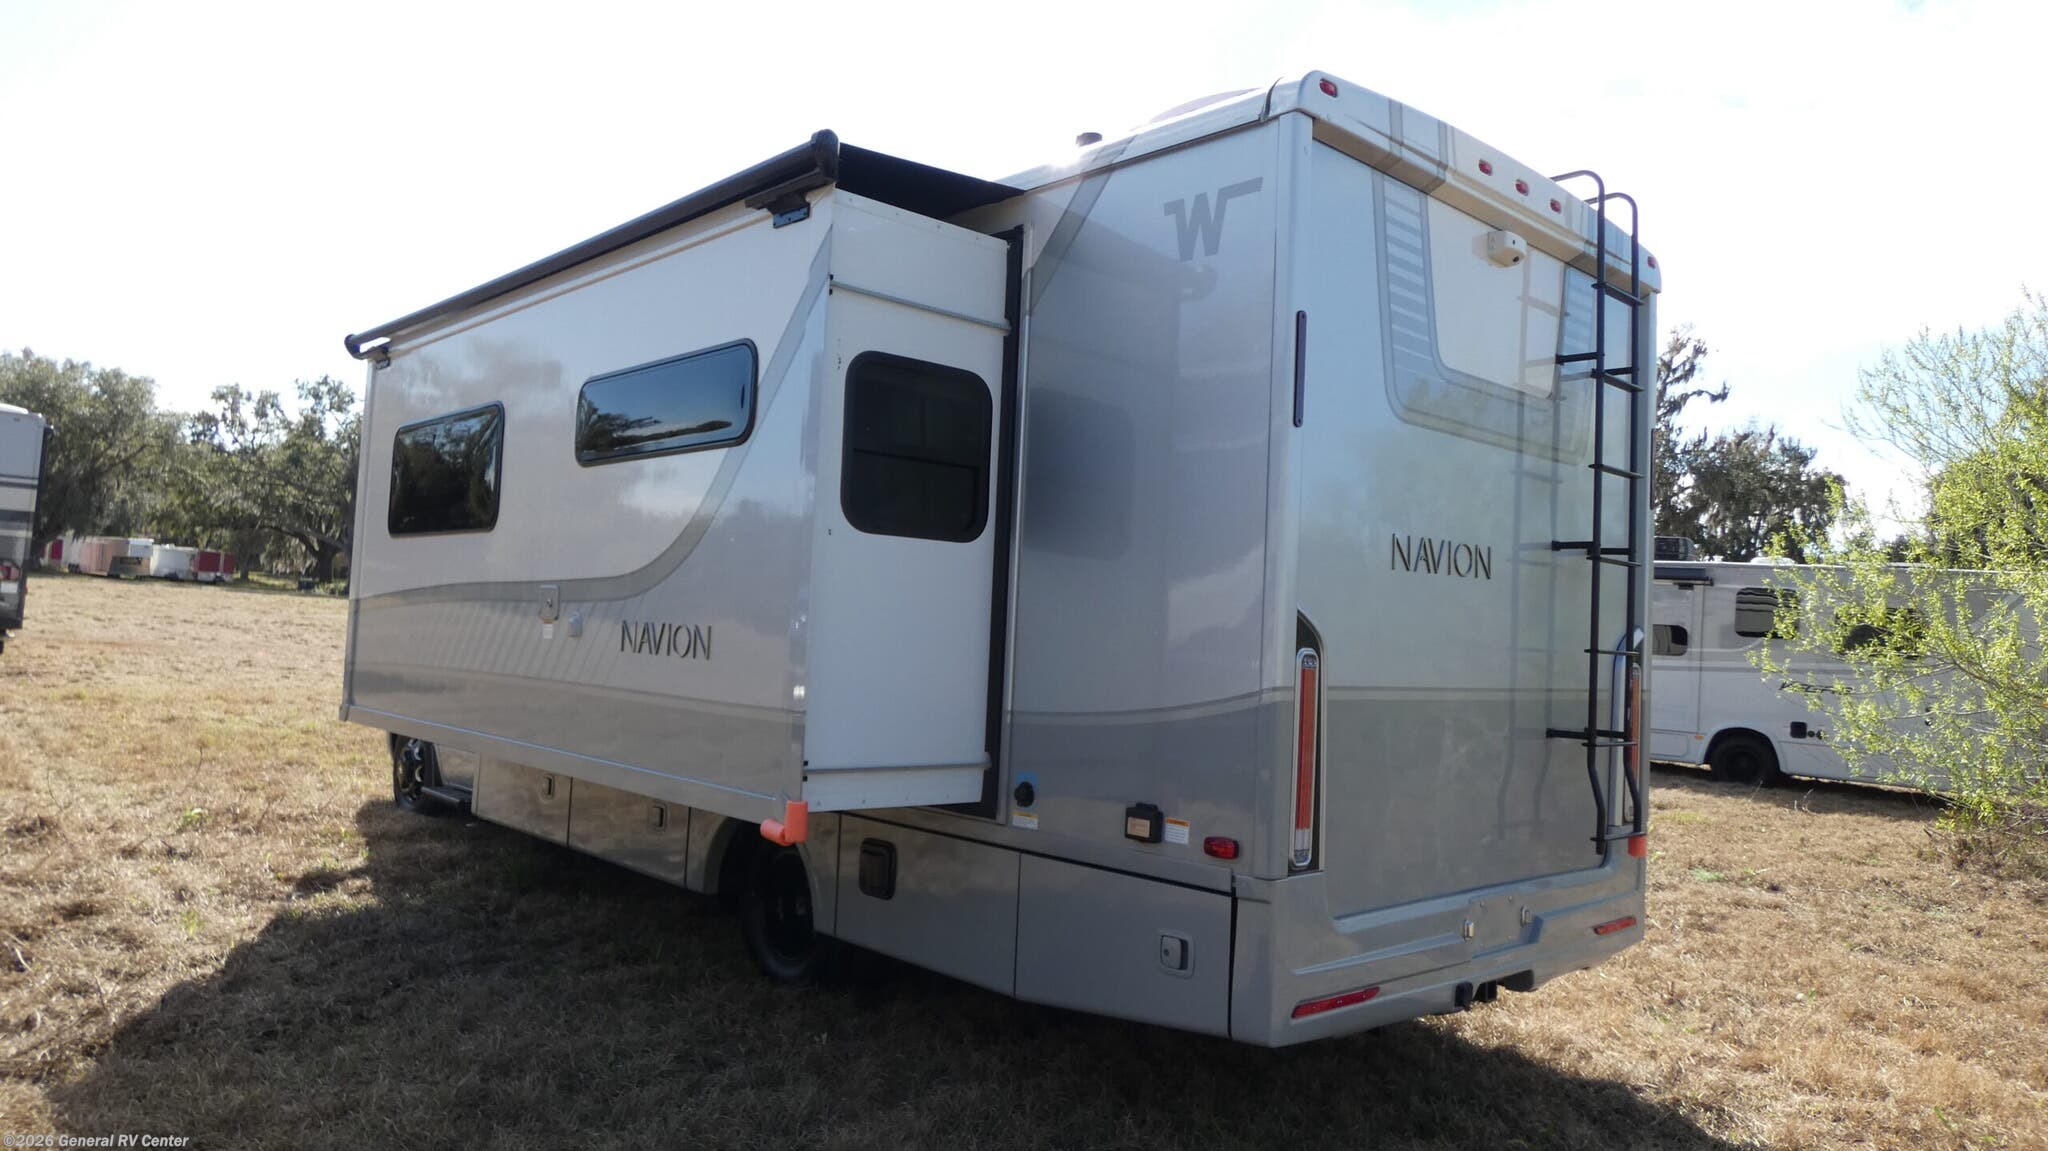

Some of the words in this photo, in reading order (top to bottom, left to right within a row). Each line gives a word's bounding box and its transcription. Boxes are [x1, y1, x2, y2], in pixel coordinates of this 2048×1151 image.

[1163, 177, 1263, 262] W
[1391, 533, 1491, 580] NAVION
[620, 620, 712, 661] NAVION
